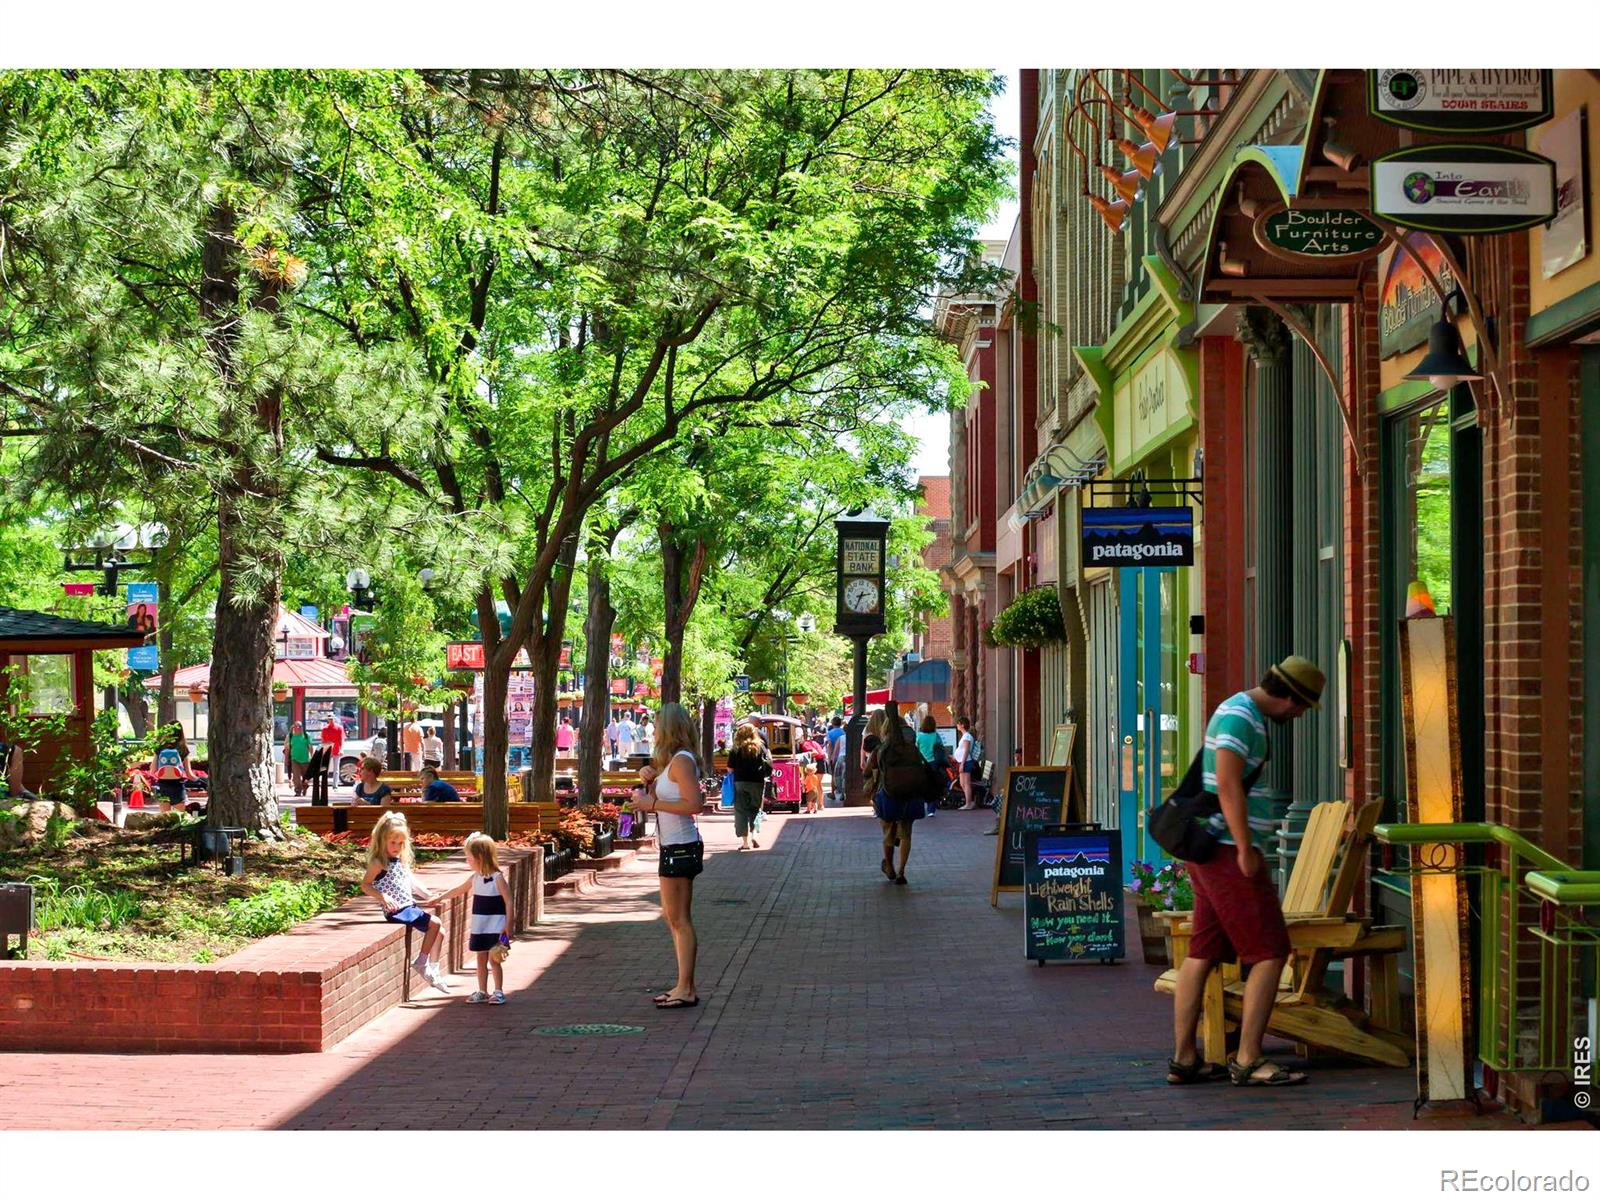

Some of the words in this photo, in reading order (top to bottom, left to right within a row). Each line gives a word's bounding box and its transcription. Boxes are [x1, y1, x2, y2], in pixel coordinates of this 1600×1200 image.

[1431, 69, 1466, 85] PIPE
[1469, 72, 1477, 85] &
[1481, 69, 1540, 85] HYDRO
[1441, 100, 1478, 110] DOWN
[1480, 100, 1528, 110] STAIRS
[1434, 171, 1463, 180] Into
[1287, 210, 1362, 225] Boulder
[1275, 225, 1376, 240] Furniture
[1301, 239, 1350, 253] Arts
[844, 541, 879, 552] NATIONAL
[1092, 542, 1184, 561] patagonia
[847, 552, 876, 562] STATE
[849, 563, 874, 572] BANK
[451, 646, 478, 662] EAST
[1015, 775, 1037, 793] 80%
[1016, 806, 1050, 820] MADE
[1044, 865, 1104, 879] patagonia
[1028, 877, 1093, 898] Lightweight
[1047, 896, 1077, 913] Rain
[1078, 891, 1115, 911] Shells
[1055, 915, 1075, 930] you
[1075, 913, 1099, 924] need
